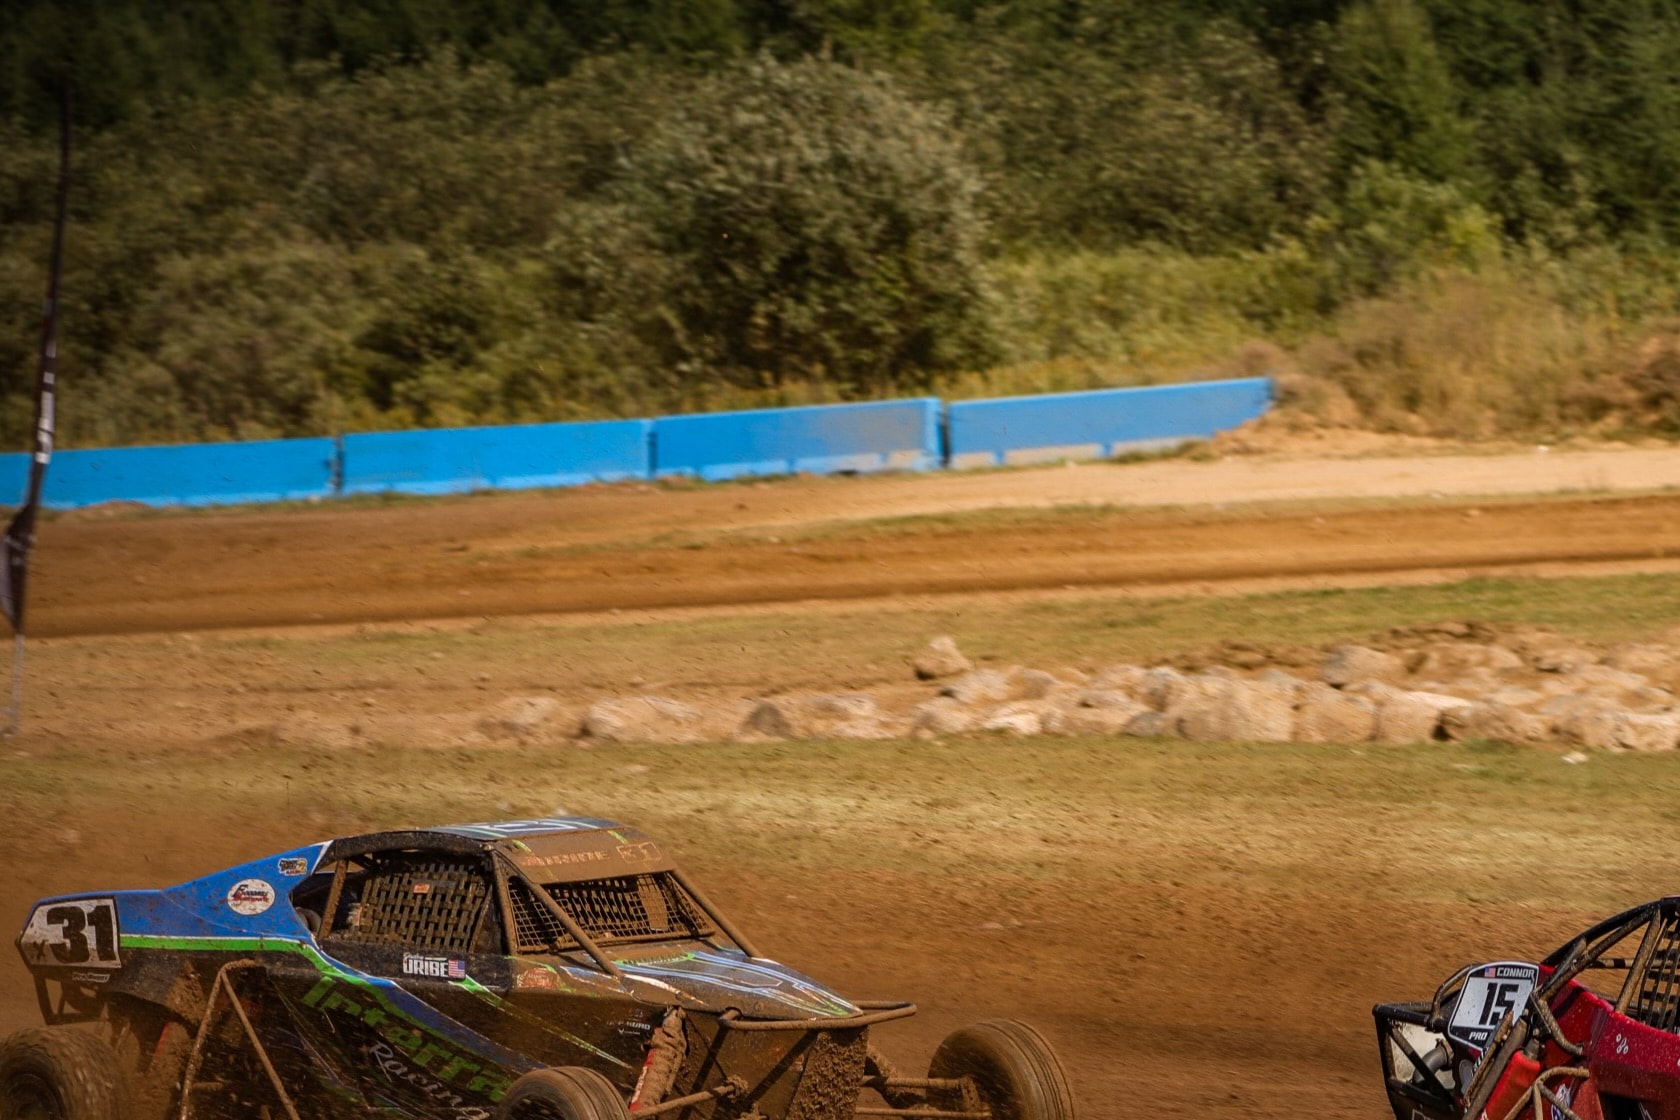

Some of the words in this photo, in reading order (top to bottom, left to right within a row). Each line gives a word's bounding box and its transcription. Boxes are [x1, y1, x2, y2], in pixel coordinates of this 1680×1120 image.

[46, 905, 117, 964] 31
[402, 957, 449, 977] URIBE
[1496, 967, 1535, 978] CONNOR
[1478, 982, 1519, 1026] 15
[1468, 1031, 1488, 1041] PRO
